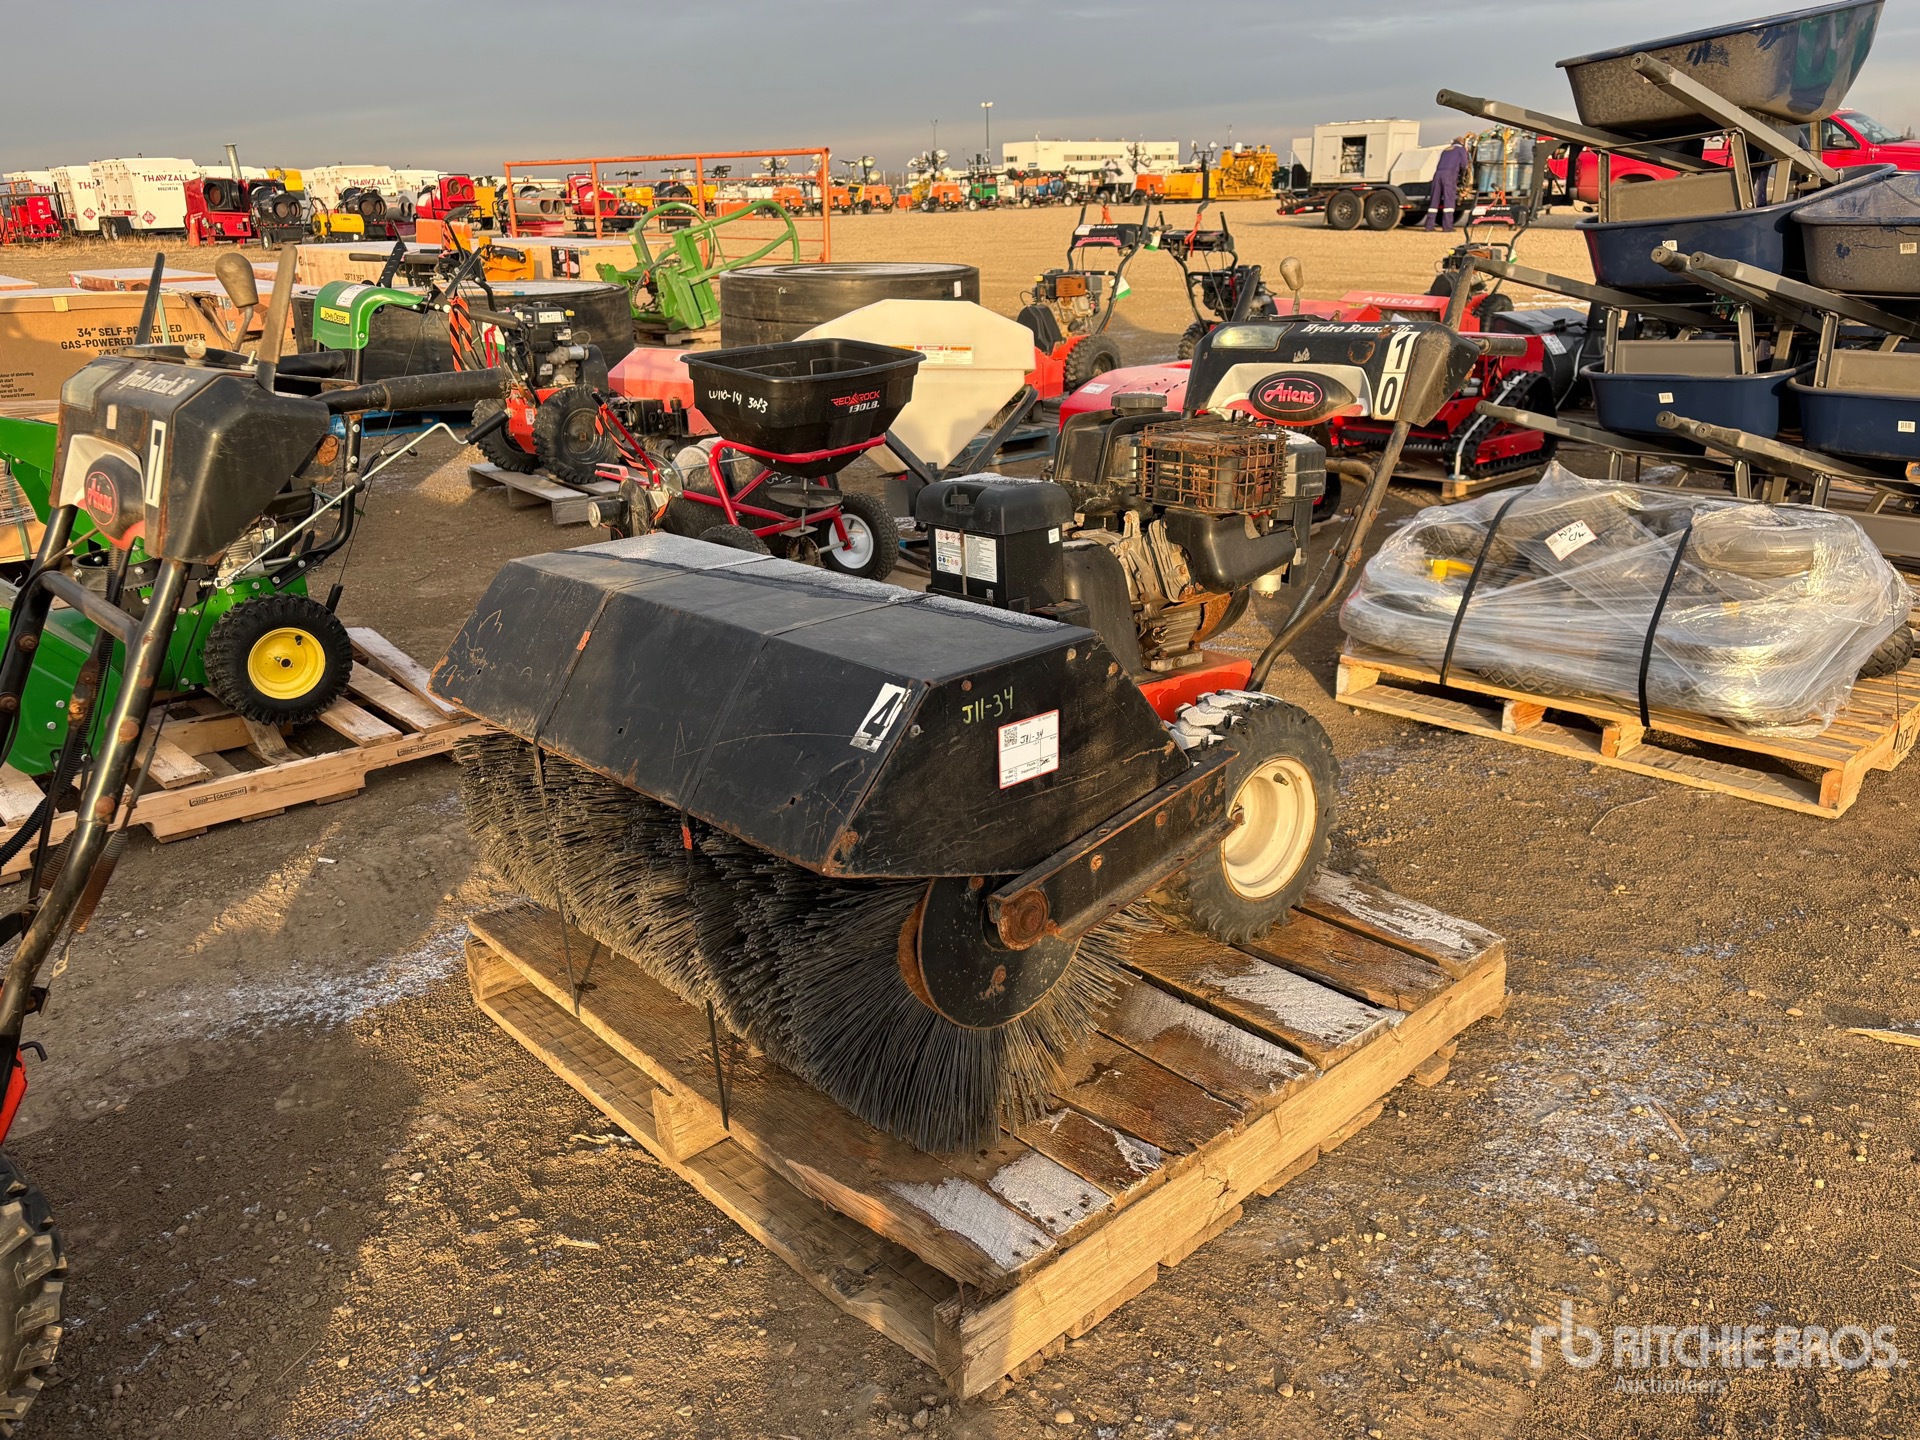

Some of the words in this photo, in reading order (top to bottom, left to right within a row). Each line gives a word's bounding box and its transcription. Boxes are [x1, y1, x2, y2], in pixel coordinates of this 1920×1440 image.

[142, 174, 190, 182] THAWZALL
[1362, 296, 1424, 306] ARIENS
[324, 310, 334, 321] JOHN
[334, 312, 346, 324] DEERE
[1300, 324, 1345, 334] Hydro
[1391, 324, 1414, 333] 36
[61, 336, 133, 350] GAS-POWERED
[1264, 382, 1316, 404] Ariens
[863, 692, 905, 747] 4
